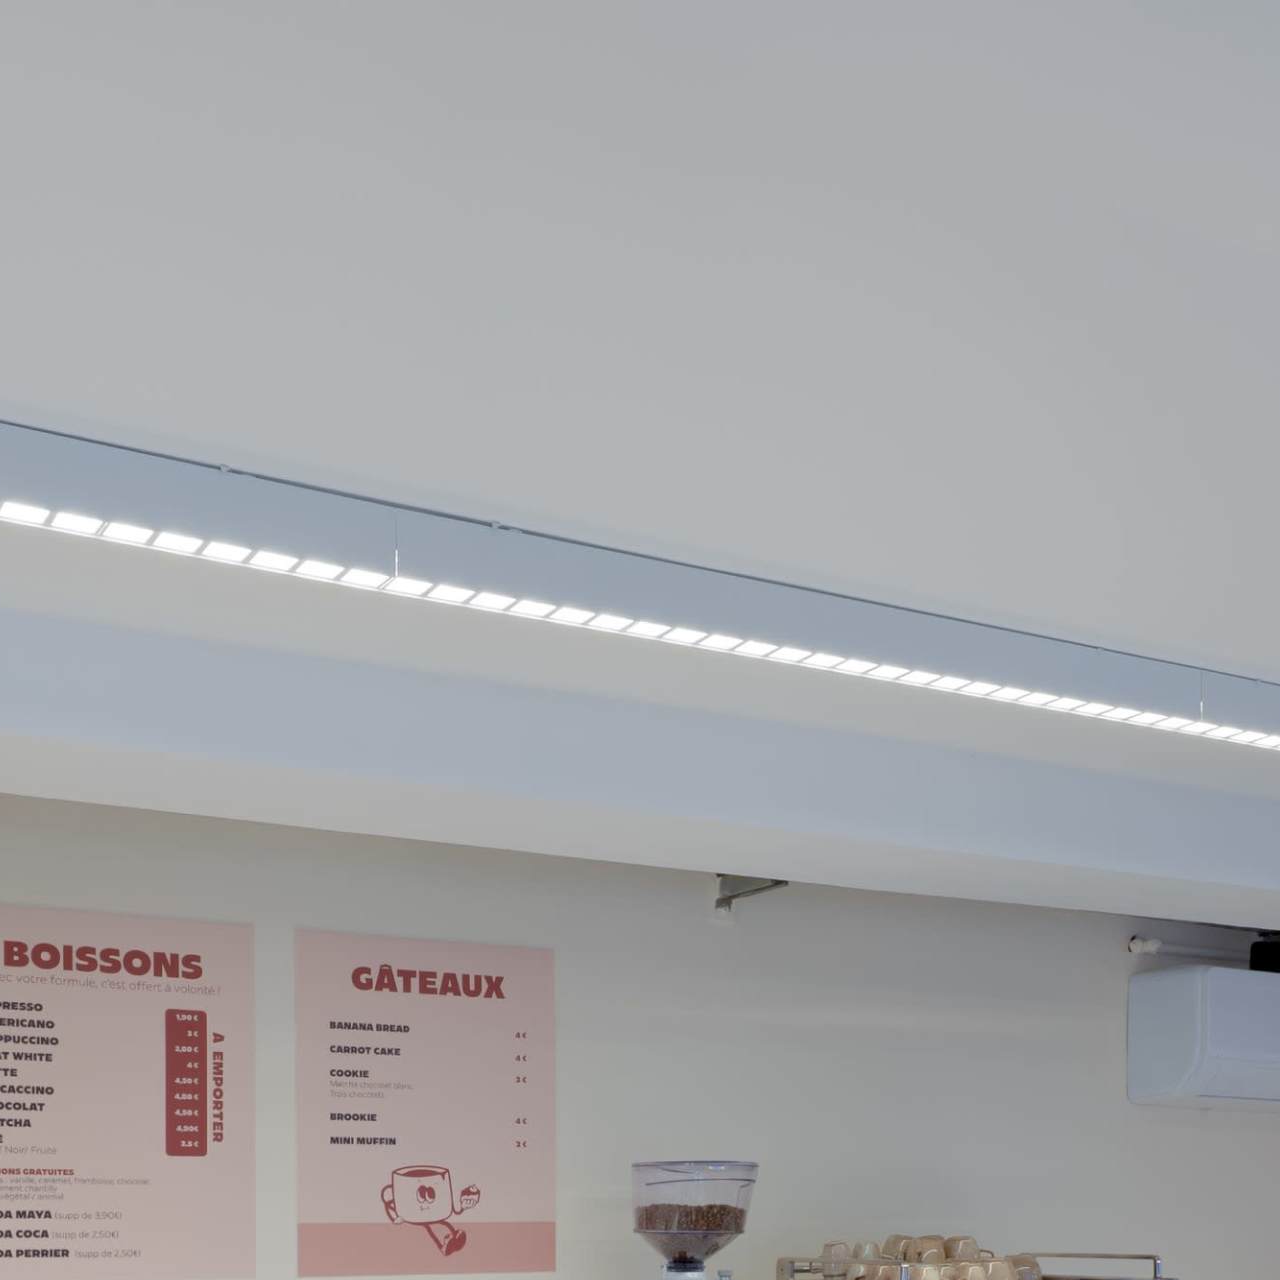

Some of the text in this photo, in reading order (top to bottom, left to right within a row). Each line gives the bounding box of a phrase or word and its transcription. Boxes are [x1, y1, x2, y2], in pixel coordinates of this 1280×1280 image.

[3, 940, 202, 980] BOISSONS
[15, 974, 46, 985] votre
[351, 964, 505, 999] GÂTEAUX
[330, 1021, 410, 1032] BANANA BREAD
[330, 1045, 401, 1056] CARROT CAKE
[13, 1051, 53, 1062] WHITE
[330, 1069, 369, 1078] COOKIE
[212, 1052, 223, 1143] EMPORTER
[330, 1113, 376, 1122] BROOKIE
[330, 1136, 397, 1145] MINI MUFFIN
[23, 1168, 74, 1176] GRATUITES
[16, 1210, 52, 1219] MAYA
[16, 1229, 49, 1238] COCA
[16, 1249, 70, 1258] PERRIER
